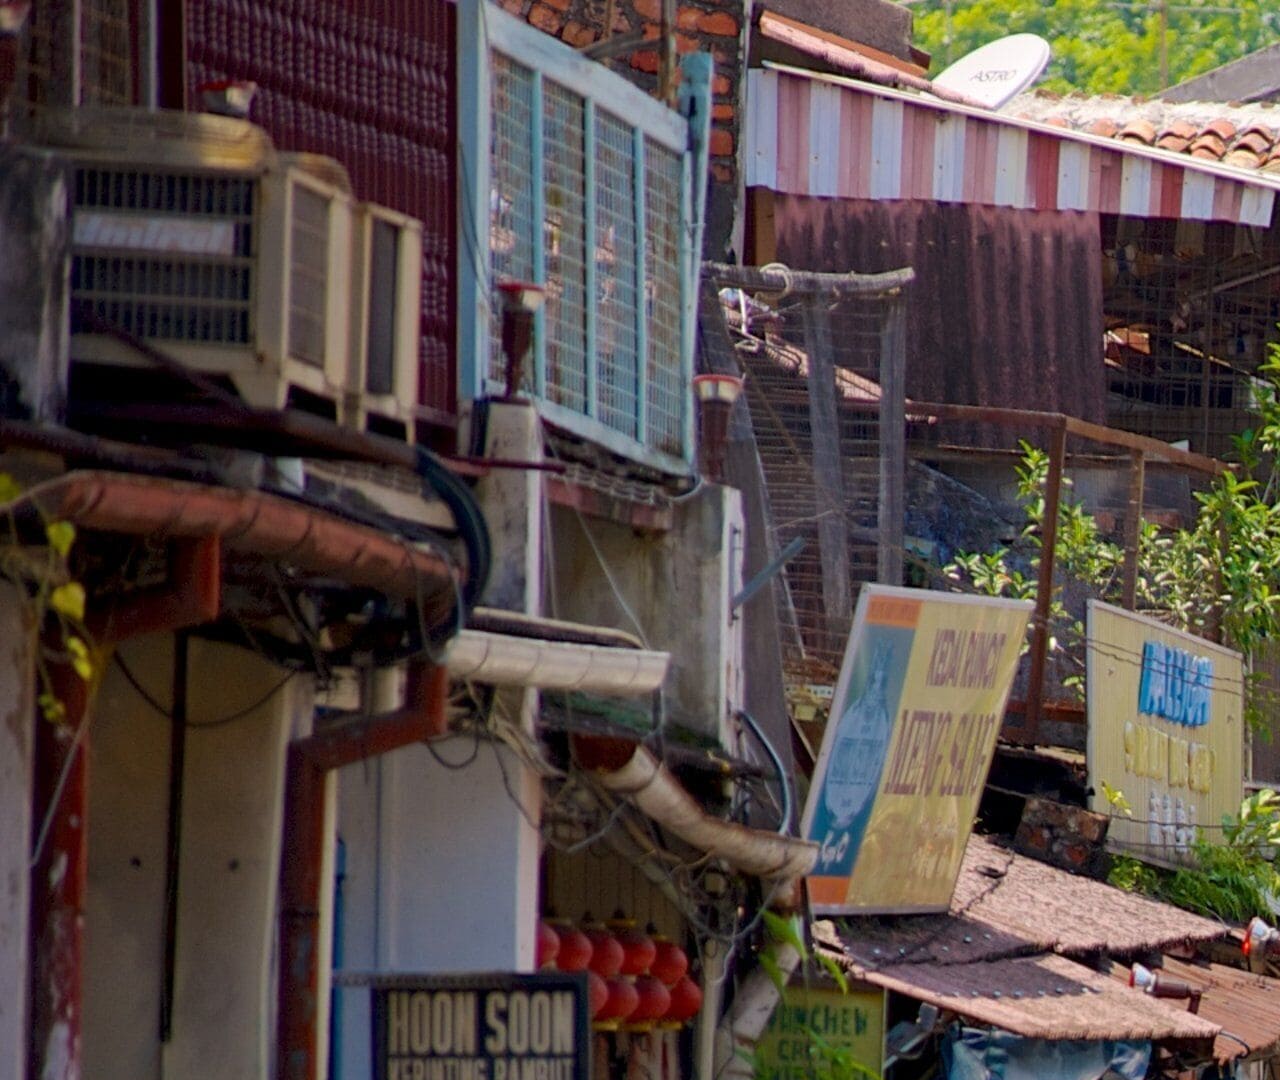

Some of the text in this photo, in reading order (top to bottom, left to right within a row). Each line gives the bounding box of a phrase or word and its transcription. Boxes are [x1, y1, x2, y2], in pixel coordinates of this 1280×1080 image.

[970, 69, 1018, 82] ASTRO
[925, 629, 969, 688] KEDAI
[388, 990, 575, 1055] HOON SOON
